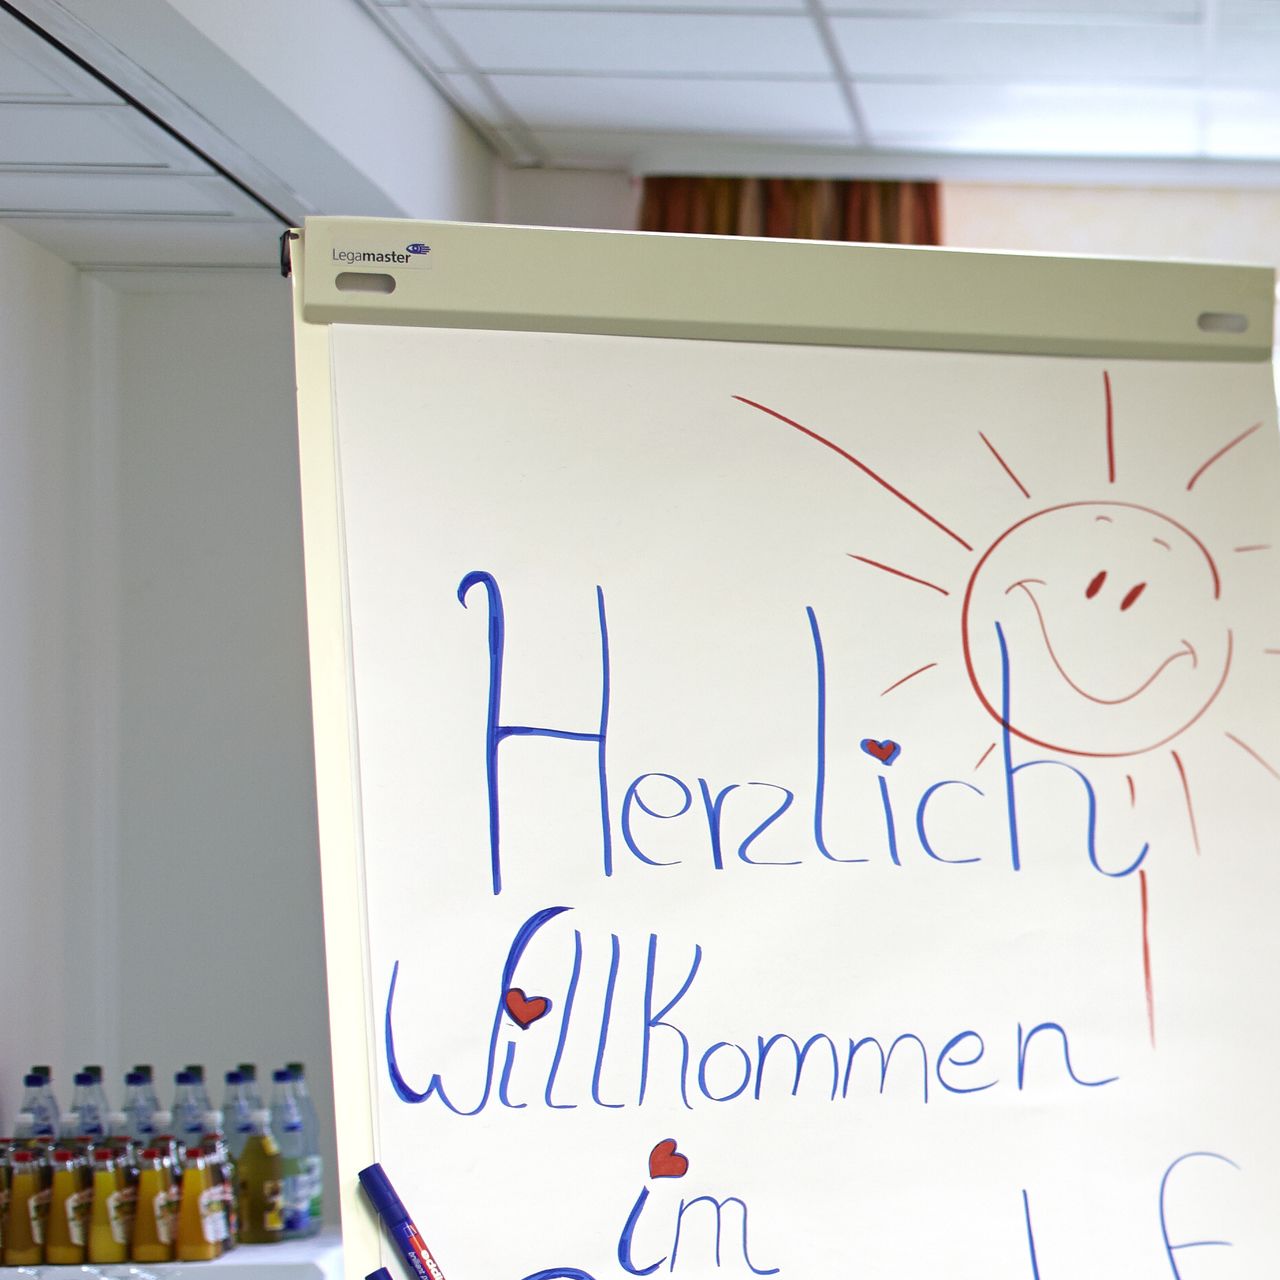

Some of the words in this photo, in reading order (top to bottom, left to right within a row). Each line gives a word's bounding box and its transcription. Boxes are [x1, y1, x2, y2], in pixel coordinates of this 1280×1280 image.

[332, 248, 411, 264] Legamaster
[457, 570, 1150, 895] Herzlich
[617, 1138, 780, 1276] im
